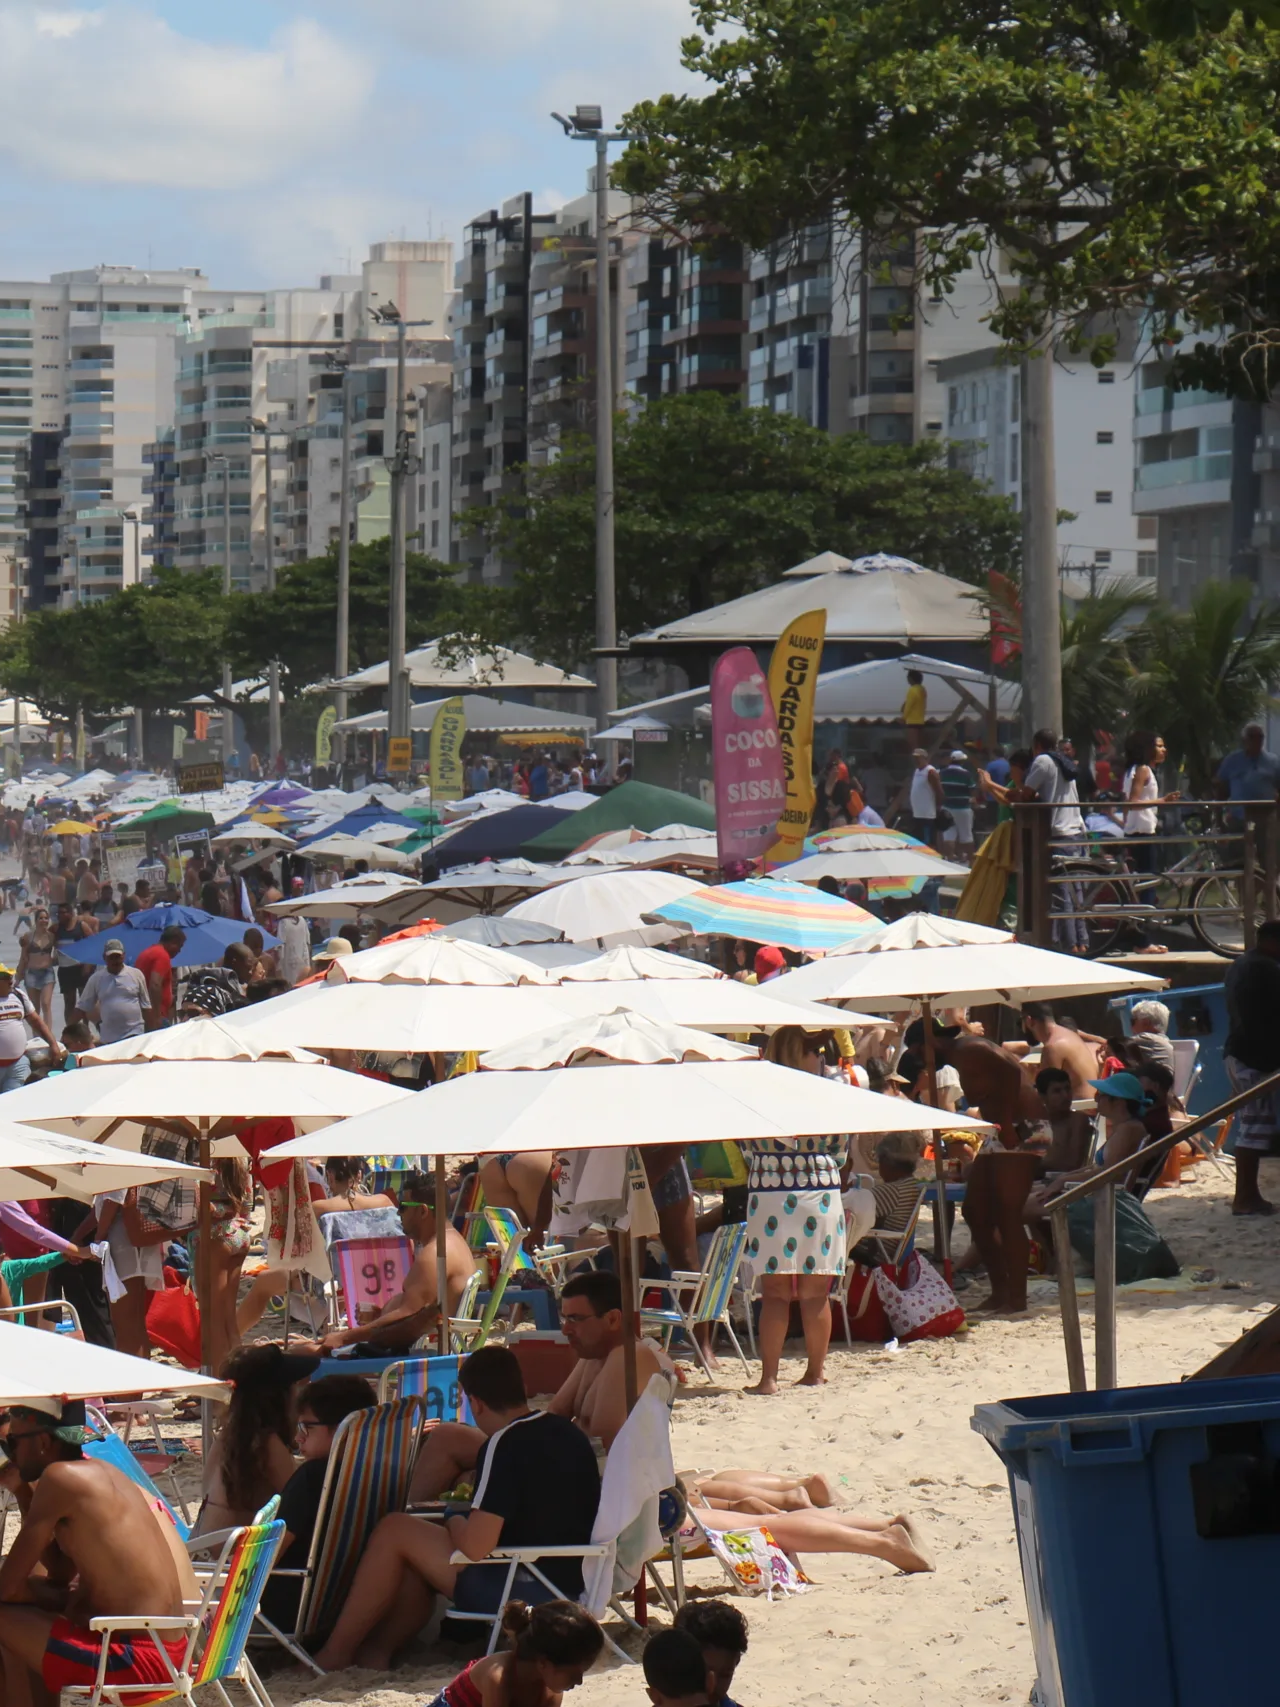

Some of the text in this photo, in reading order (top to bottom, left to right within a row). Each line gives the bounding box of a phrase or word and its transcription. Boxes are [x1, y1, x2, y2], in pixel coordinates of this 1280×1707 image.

[788, 634, 819, 651] ALUGO
[725, 728, 777, 753] COCO
[747, 757, 762, 768] DA
[727, 779, 785, 804] SISSA
